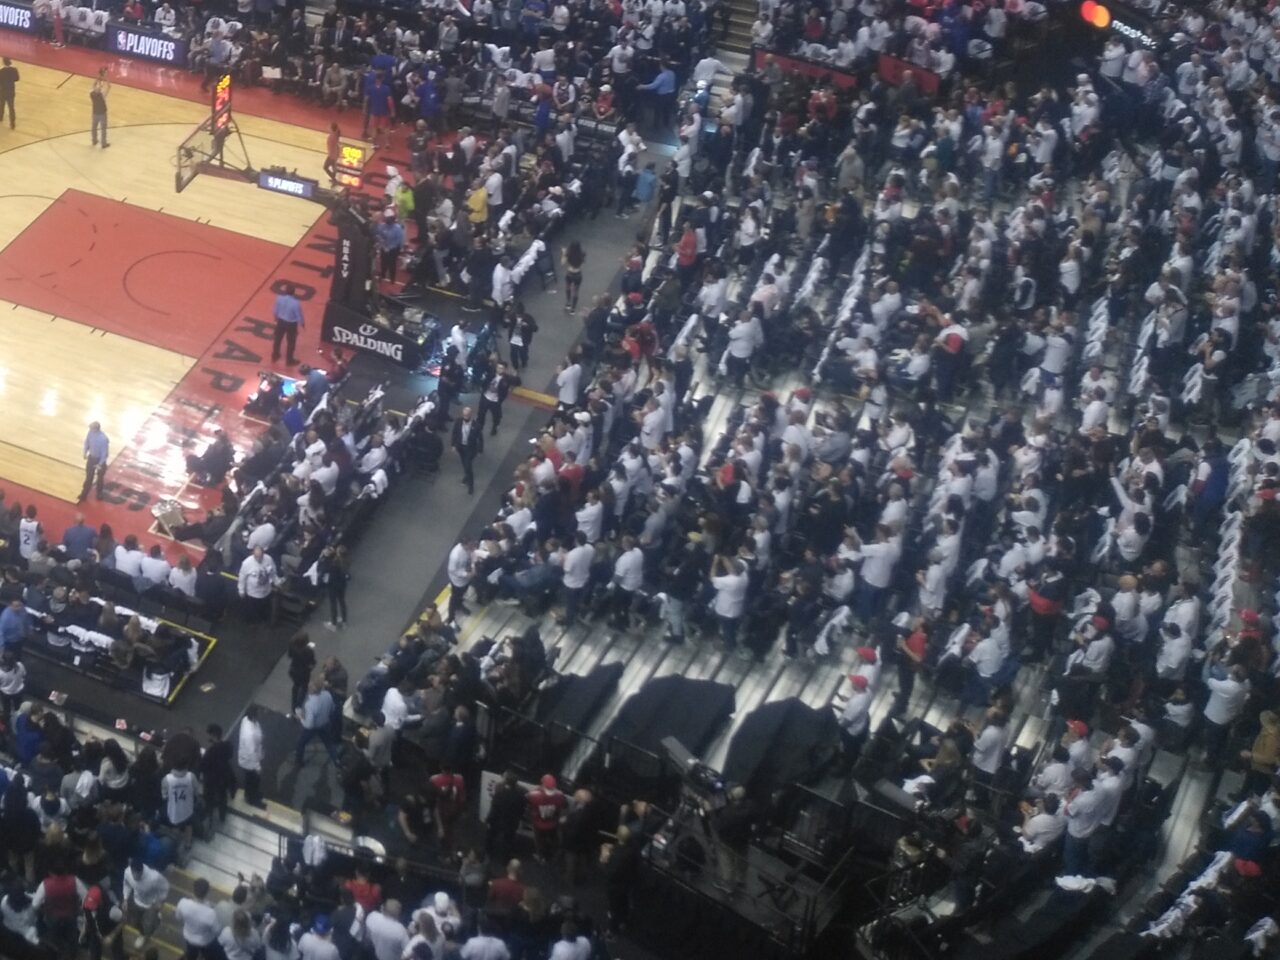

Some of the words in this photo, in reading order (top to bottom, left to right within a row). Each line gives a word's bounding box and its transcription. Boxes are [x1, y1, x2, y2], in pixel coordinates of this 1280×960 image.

[126, 32, 175, 61] PLAYOFFS
[332, 325, 403, 362] SPALDING
[23, 533, 31, 546] 2
